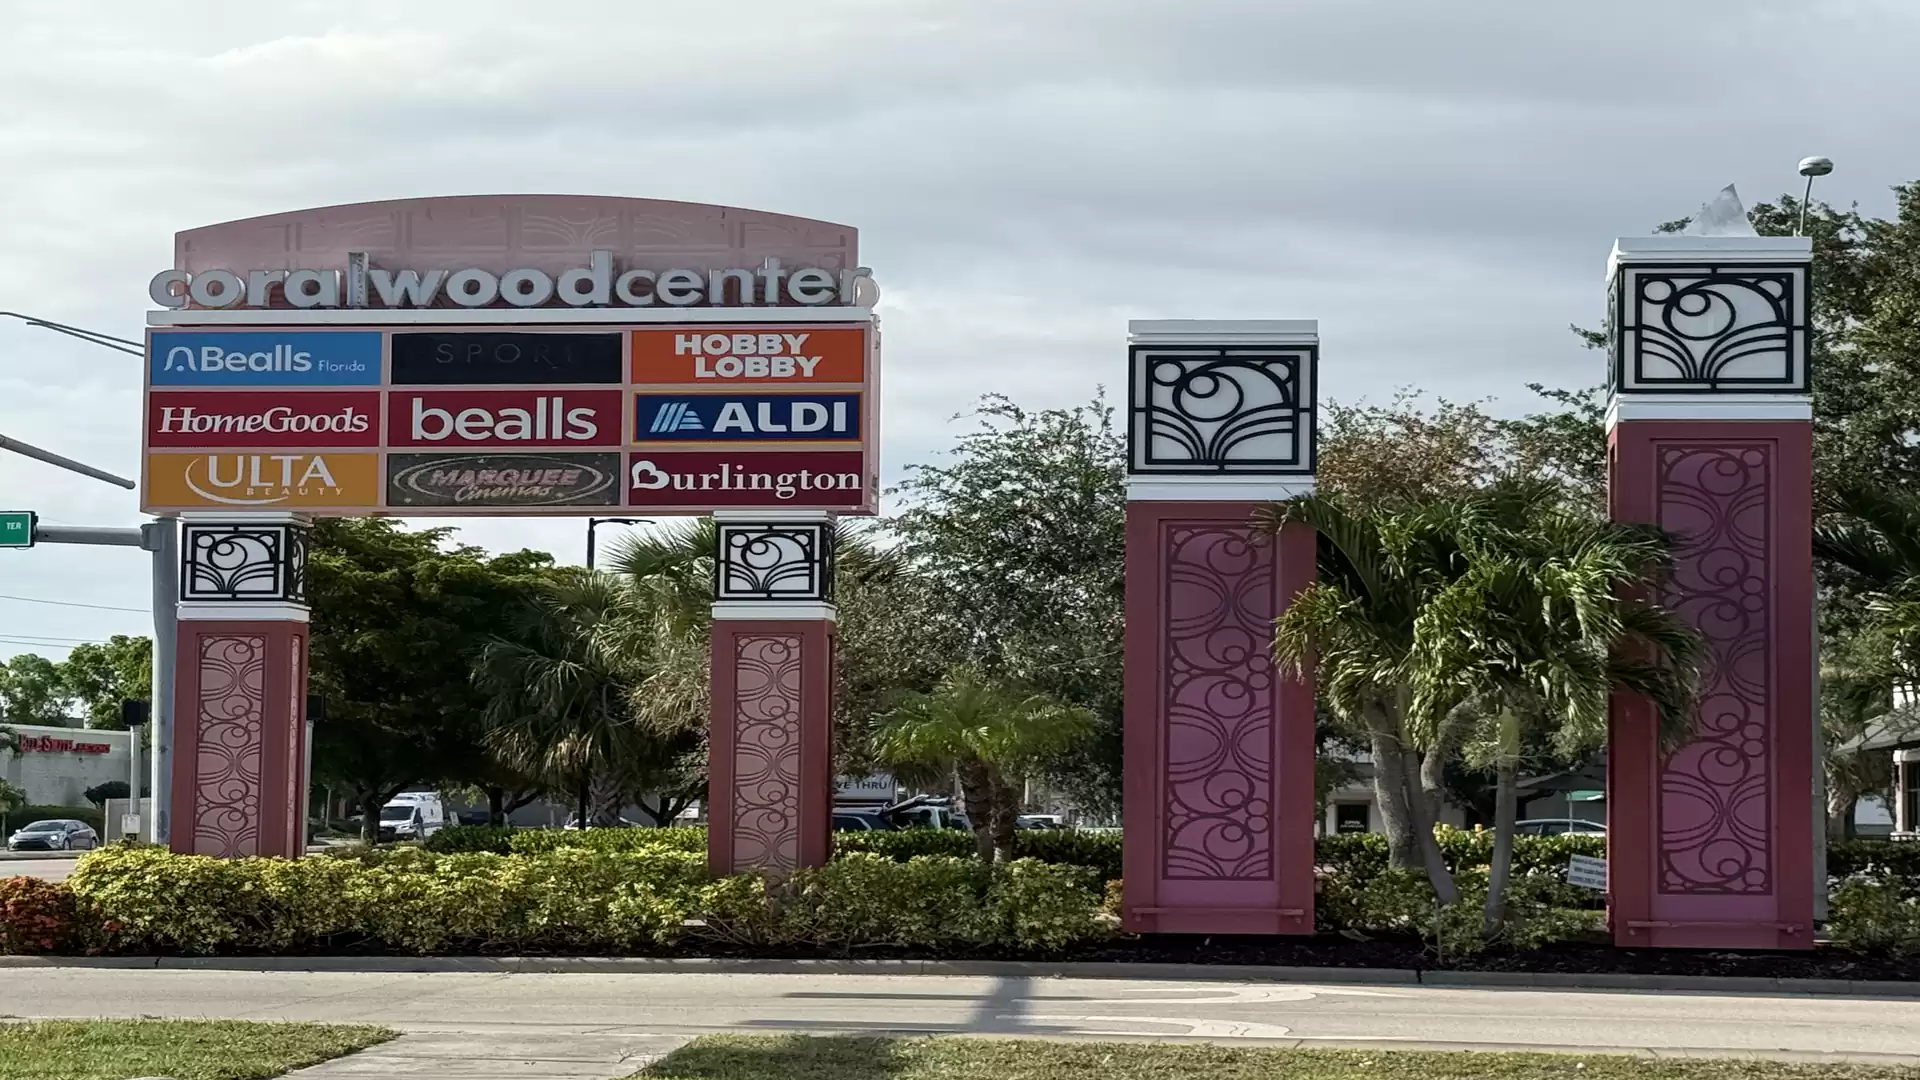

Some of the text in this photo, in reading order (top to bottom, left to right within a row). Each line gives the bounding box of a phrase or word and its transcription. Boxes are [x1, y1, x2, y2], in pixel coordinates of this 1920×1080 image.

[674, 333, 810, 356] HOBBY
[200, 345, 366, 373] Bealls Florida
[694, 356, 822, 379] LOBBY
[157, 406, 369, 434] HomeGoods
[411, 396, 598, 442] bealls
[712, 402, 848, 433] ALDI
[208, 455, 337, 487] ULTA
[428, 469, 582, 487] MARQUEE
[631, 460, 863, 499] Burlington
[246, 486, 345, 497] BEAUTY
[455, 484, 553, 502] Cinemas
[6, 521, 22, 530] TER
[855, 782, 887, 790] THRU
